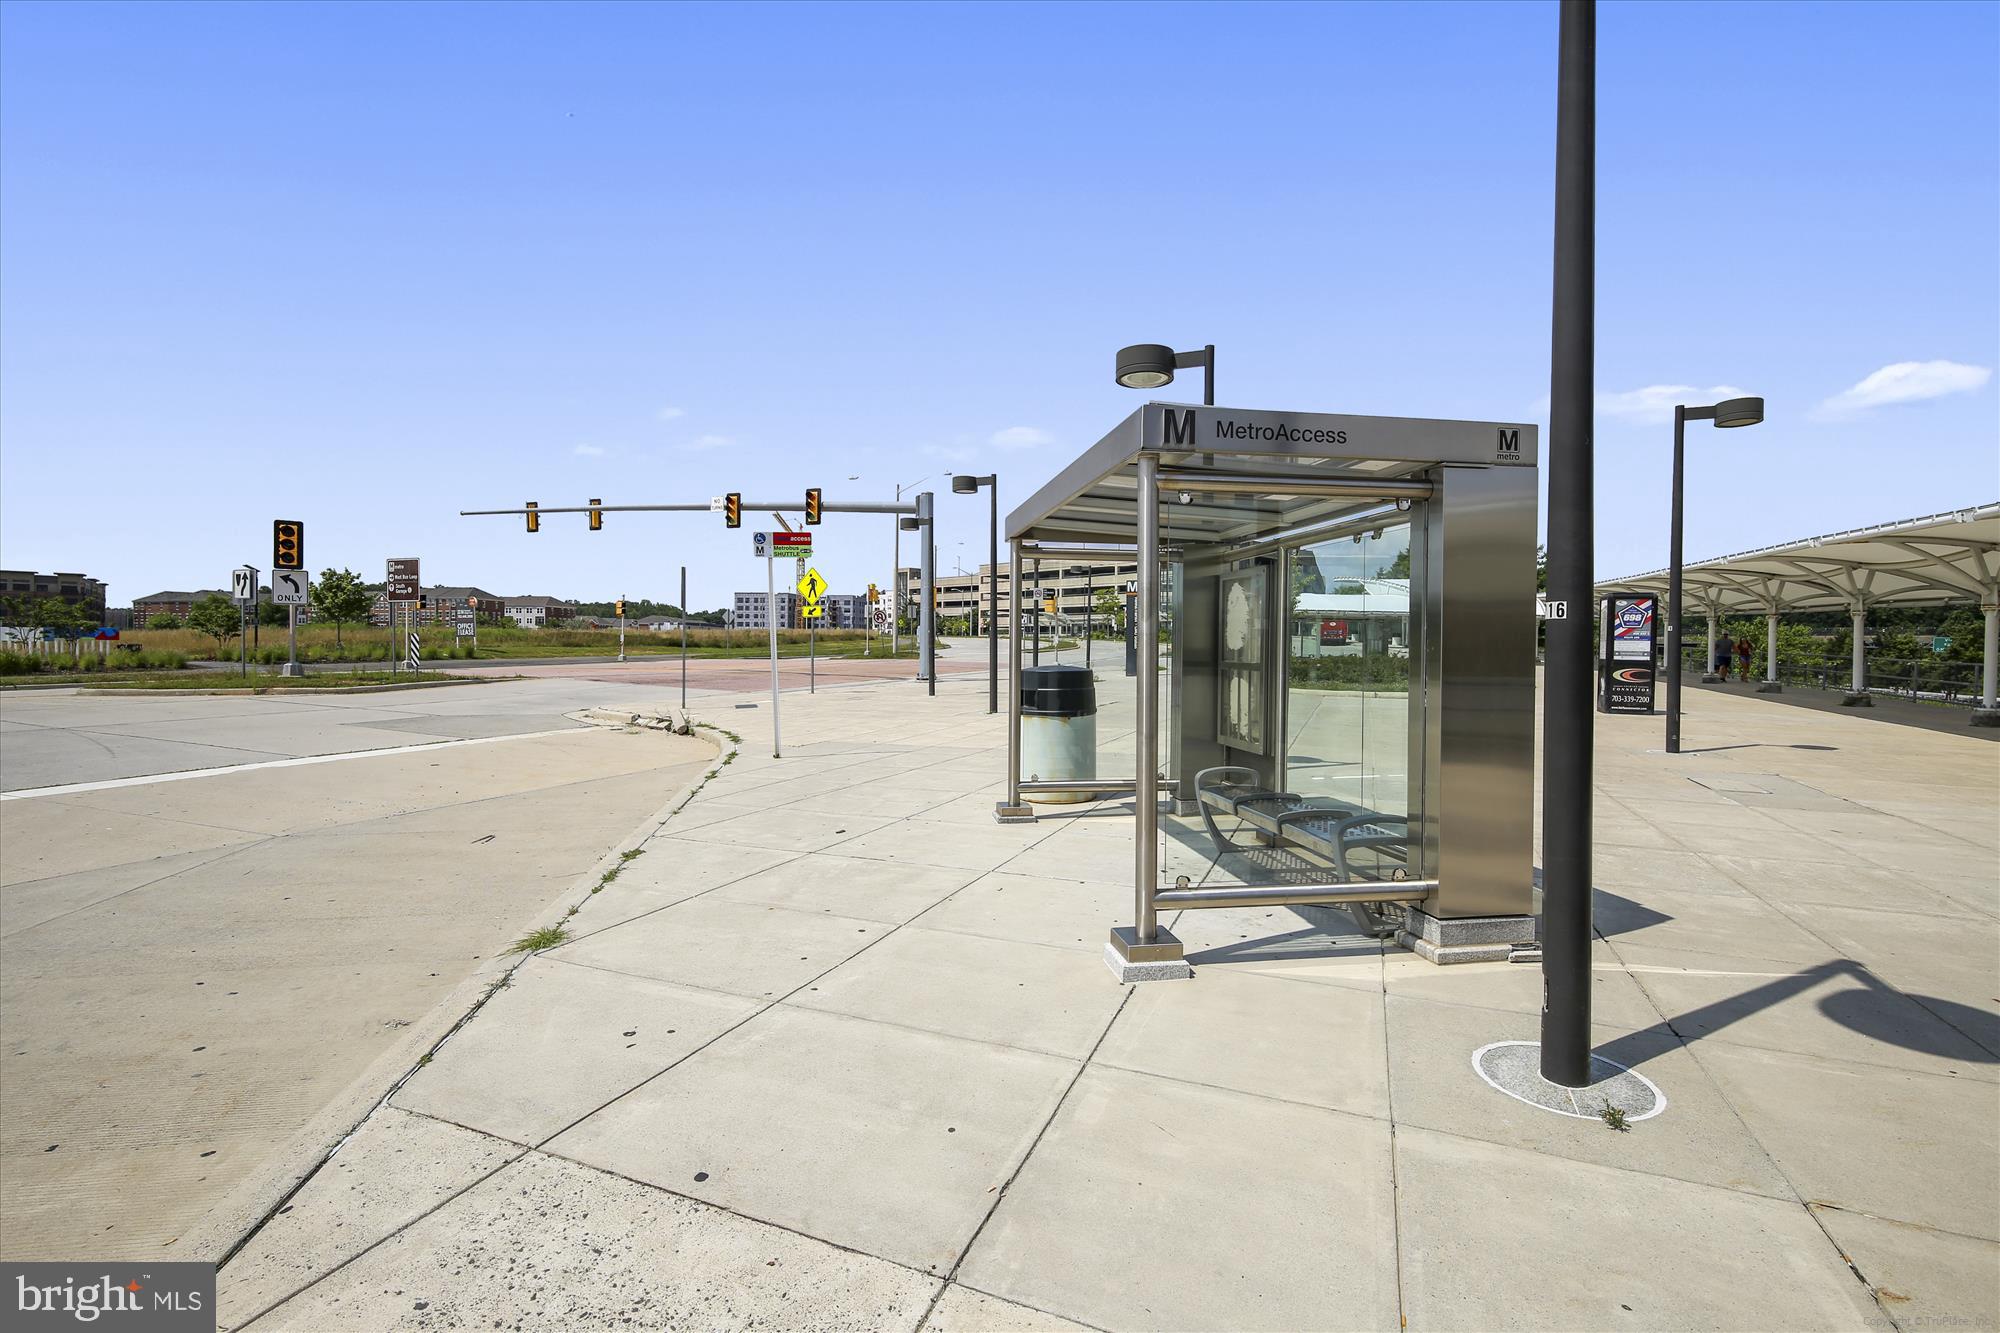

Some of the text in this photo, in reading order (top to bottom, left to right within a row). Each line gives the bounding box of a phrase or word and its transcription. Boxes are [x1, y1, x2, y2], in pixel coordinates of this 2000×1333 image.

[1163, 408, 1347, 445] M MetroAccess
[1499, 429, 1519, 452] M
[1496, 452, 1520, 461] metro
[756, 546, 764, 554] M
[1549, 602, 1565, 618] 16
[1623, 614, 1642, 622] 698
[1611, 695, 1650, 703] 703-339-7200
